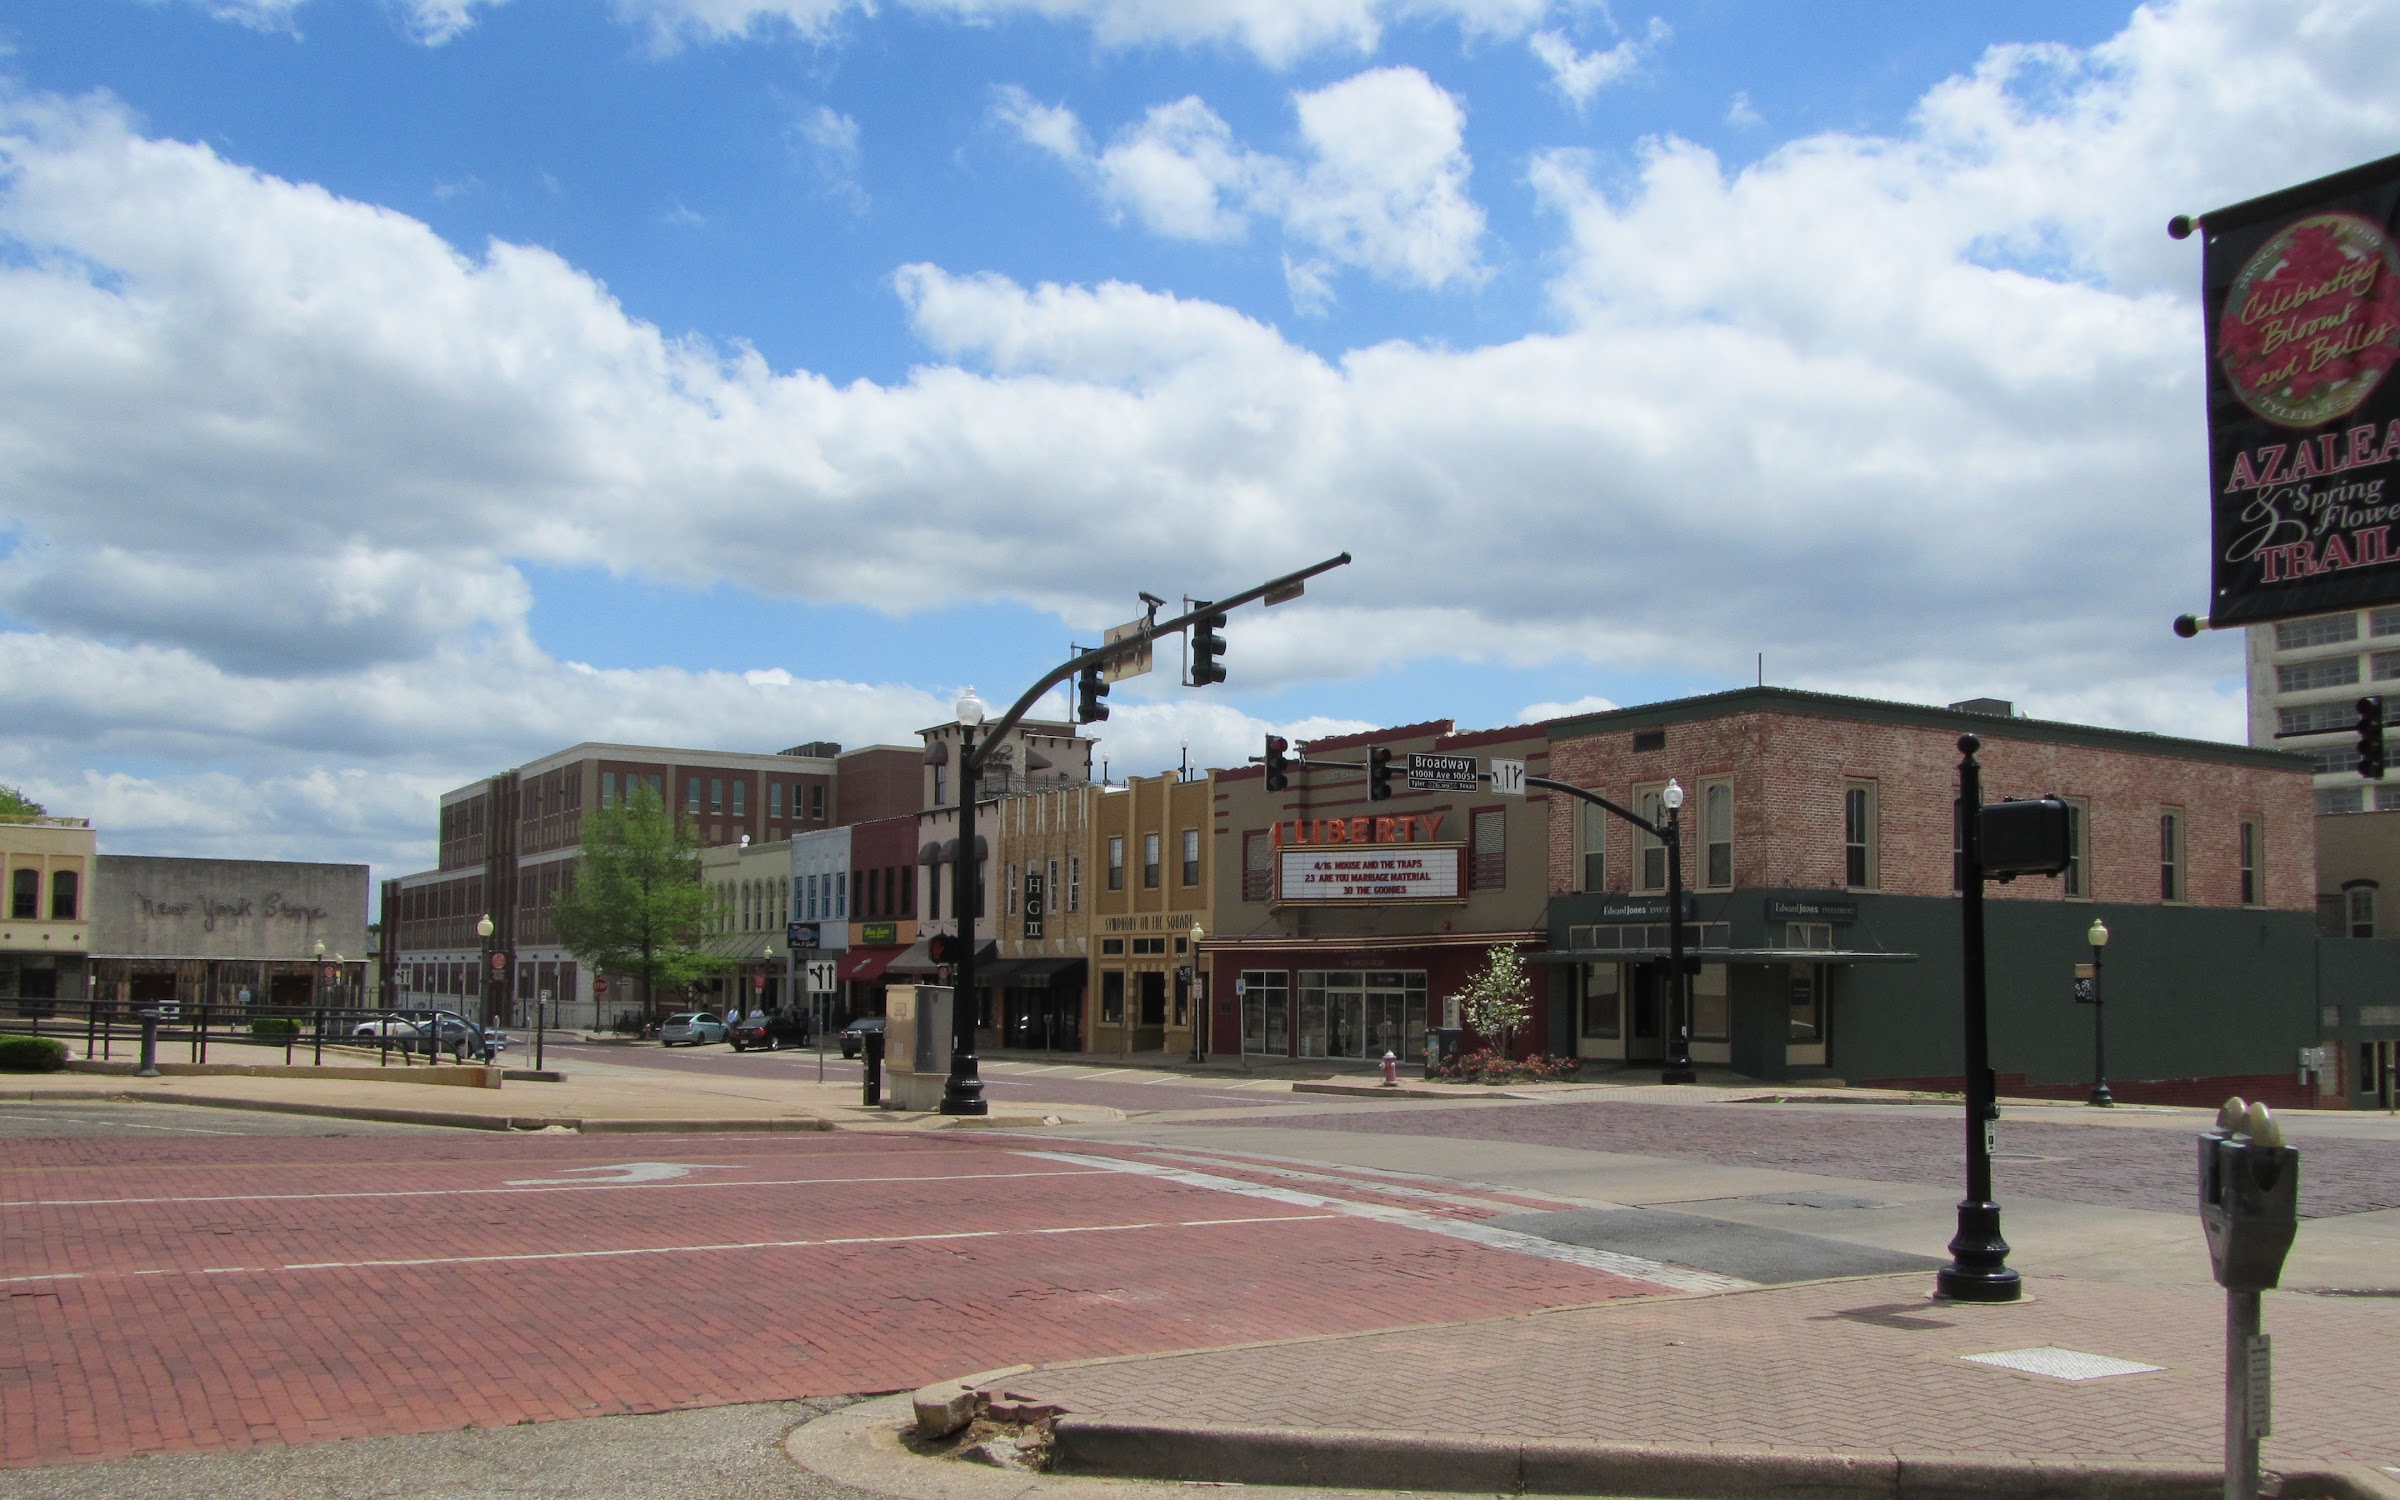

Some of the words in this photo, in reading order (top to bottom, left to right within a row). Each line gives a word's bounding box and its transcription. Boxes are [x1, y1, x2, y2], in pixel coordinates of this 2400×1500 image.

[2241, 259, 2382, 326] Celebrating
[2260, 303, 2358, 355] Blooms
[2256, 355, 2303, 388] and
[2305, 322, 2396, 373] Belles
[2224, 418, 2400, 494] AZALEA
[2293, 479, 2386, 516] Spring
[2254, 525, 2400, 584] TRAIL
[1415, 756, 1470, 773] Broadway
[1415, 770, 1434, 779] 100N
[1436, 771, 1450, 779] Ave
[1453, 772, 1471, 780] 100S
[1411, 780, 1425, 788] Tyler
[1294, 815, 1444, 845] LIBERTY
[1305, 874, 1316, 883] 23
[1319, 874, 1334, 882] ARE
[1335, 874, 1350, 882] YOU
[1351, 873, 1389, 882] MARRIAGE
[1391, 872, 1431, 881] MATERIAL
[1335, 861, 1362, 870] MOUSE
[1363, 861, 1378, 869] AND
[1381, 860, 1396, 869] THE
[1397, 859, 1422, 868] TRAPS
[1344, 886, 1353, 895] 30
[1357, 886, 1370, 895] THE
[1374, 885, 1407, 894] GOONIES
[200, 894, 253, 932] York
[265, 890, 328, 922] Store
[1105, 917, 1136, 932] SYMPHONY
[1140, 919, 1148, 930] ON
[1152, 917, 1162, 930] THE
[1167, 914, 1194, 929] SQUARE
